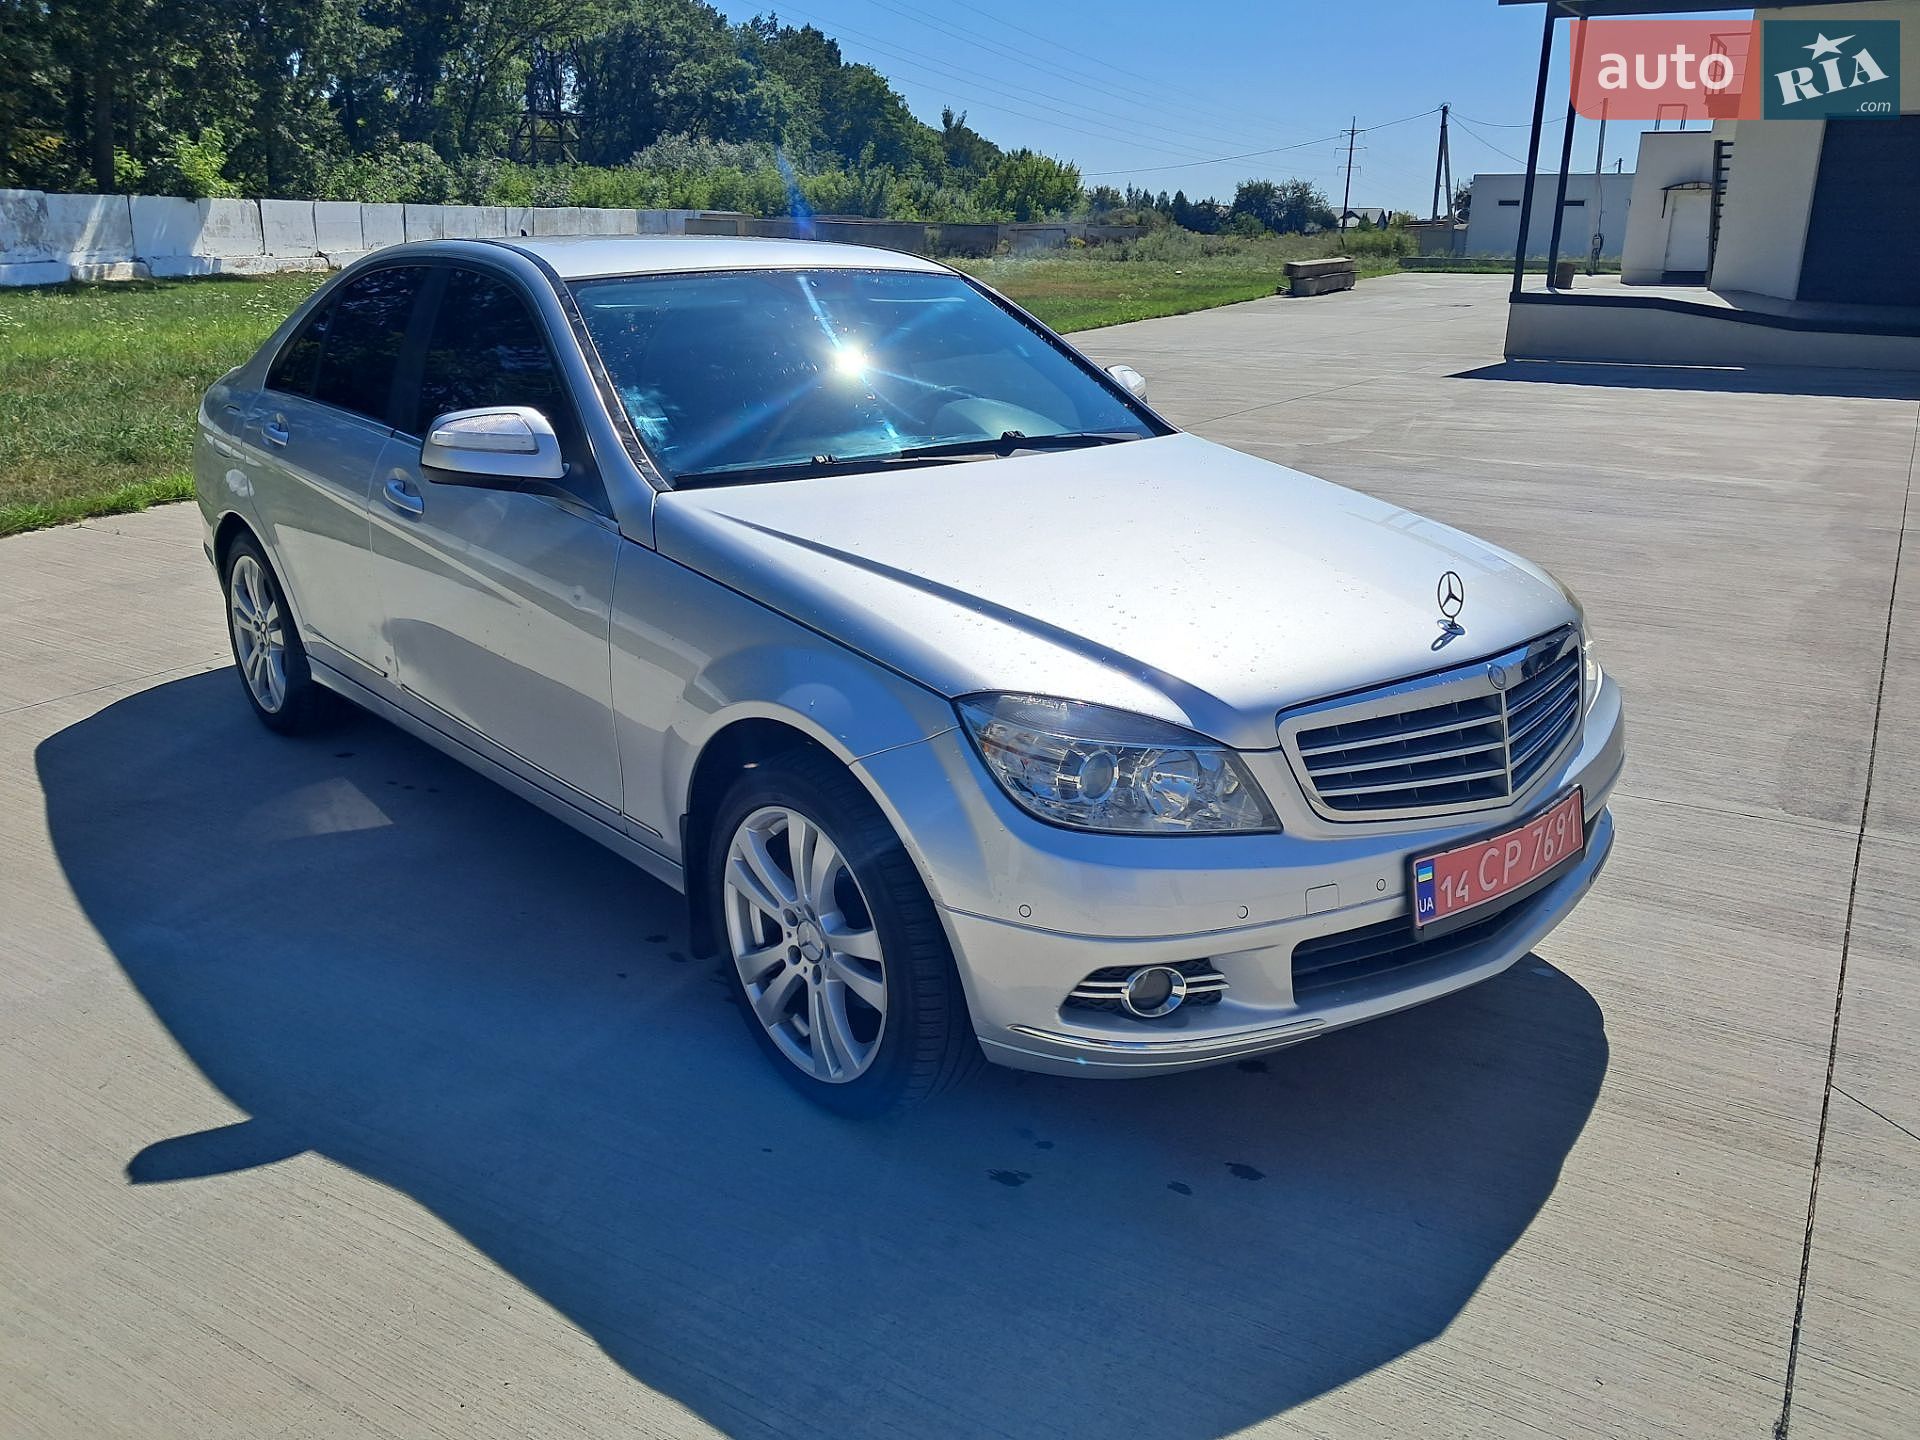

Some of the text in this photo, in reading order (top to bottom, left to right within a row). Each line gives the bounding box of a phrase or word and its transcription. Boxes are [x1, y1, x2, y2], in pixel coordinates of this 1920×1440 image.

[1440, 803, 1577, 908] 14 CP 7691
[1418, 896, 1434, 913] UA
